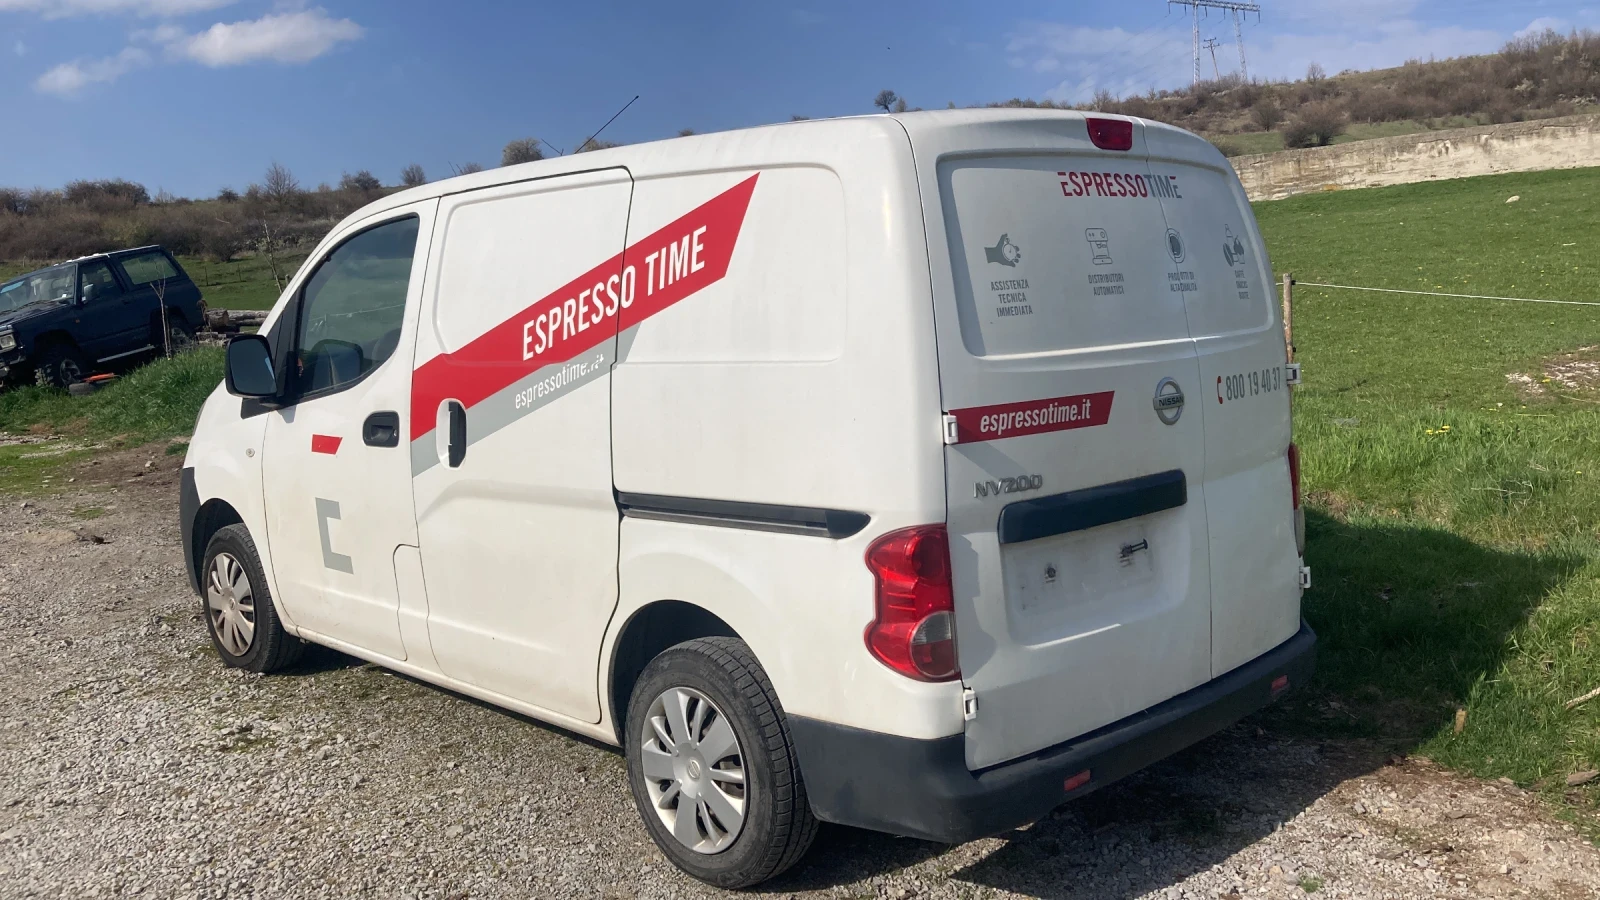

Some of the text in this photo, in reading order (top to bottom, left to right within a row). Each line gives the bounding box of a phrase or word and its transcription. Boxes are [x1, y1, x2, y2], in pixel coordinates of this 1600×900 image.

[1087, 273, 1125, 284] DISTRIBUTORI
[990, 279, 1030, 291] ASSISTENZA
[1093, 285, 1125, 296] AUTOMATICI
[522, 224, 707, 361] ESPRESSO TIME
[997, 292, 1027, 304] TECNICA
[996, 305, 1033, 317] IMMEDIATA
[1225, 366, 1281, 401] 800 19 40 37
[1158, 396, 1185, 407] NISSAN
[980, 398, 1092, 436] espressotime.it
[972, 474, 1043, 499] NV200
